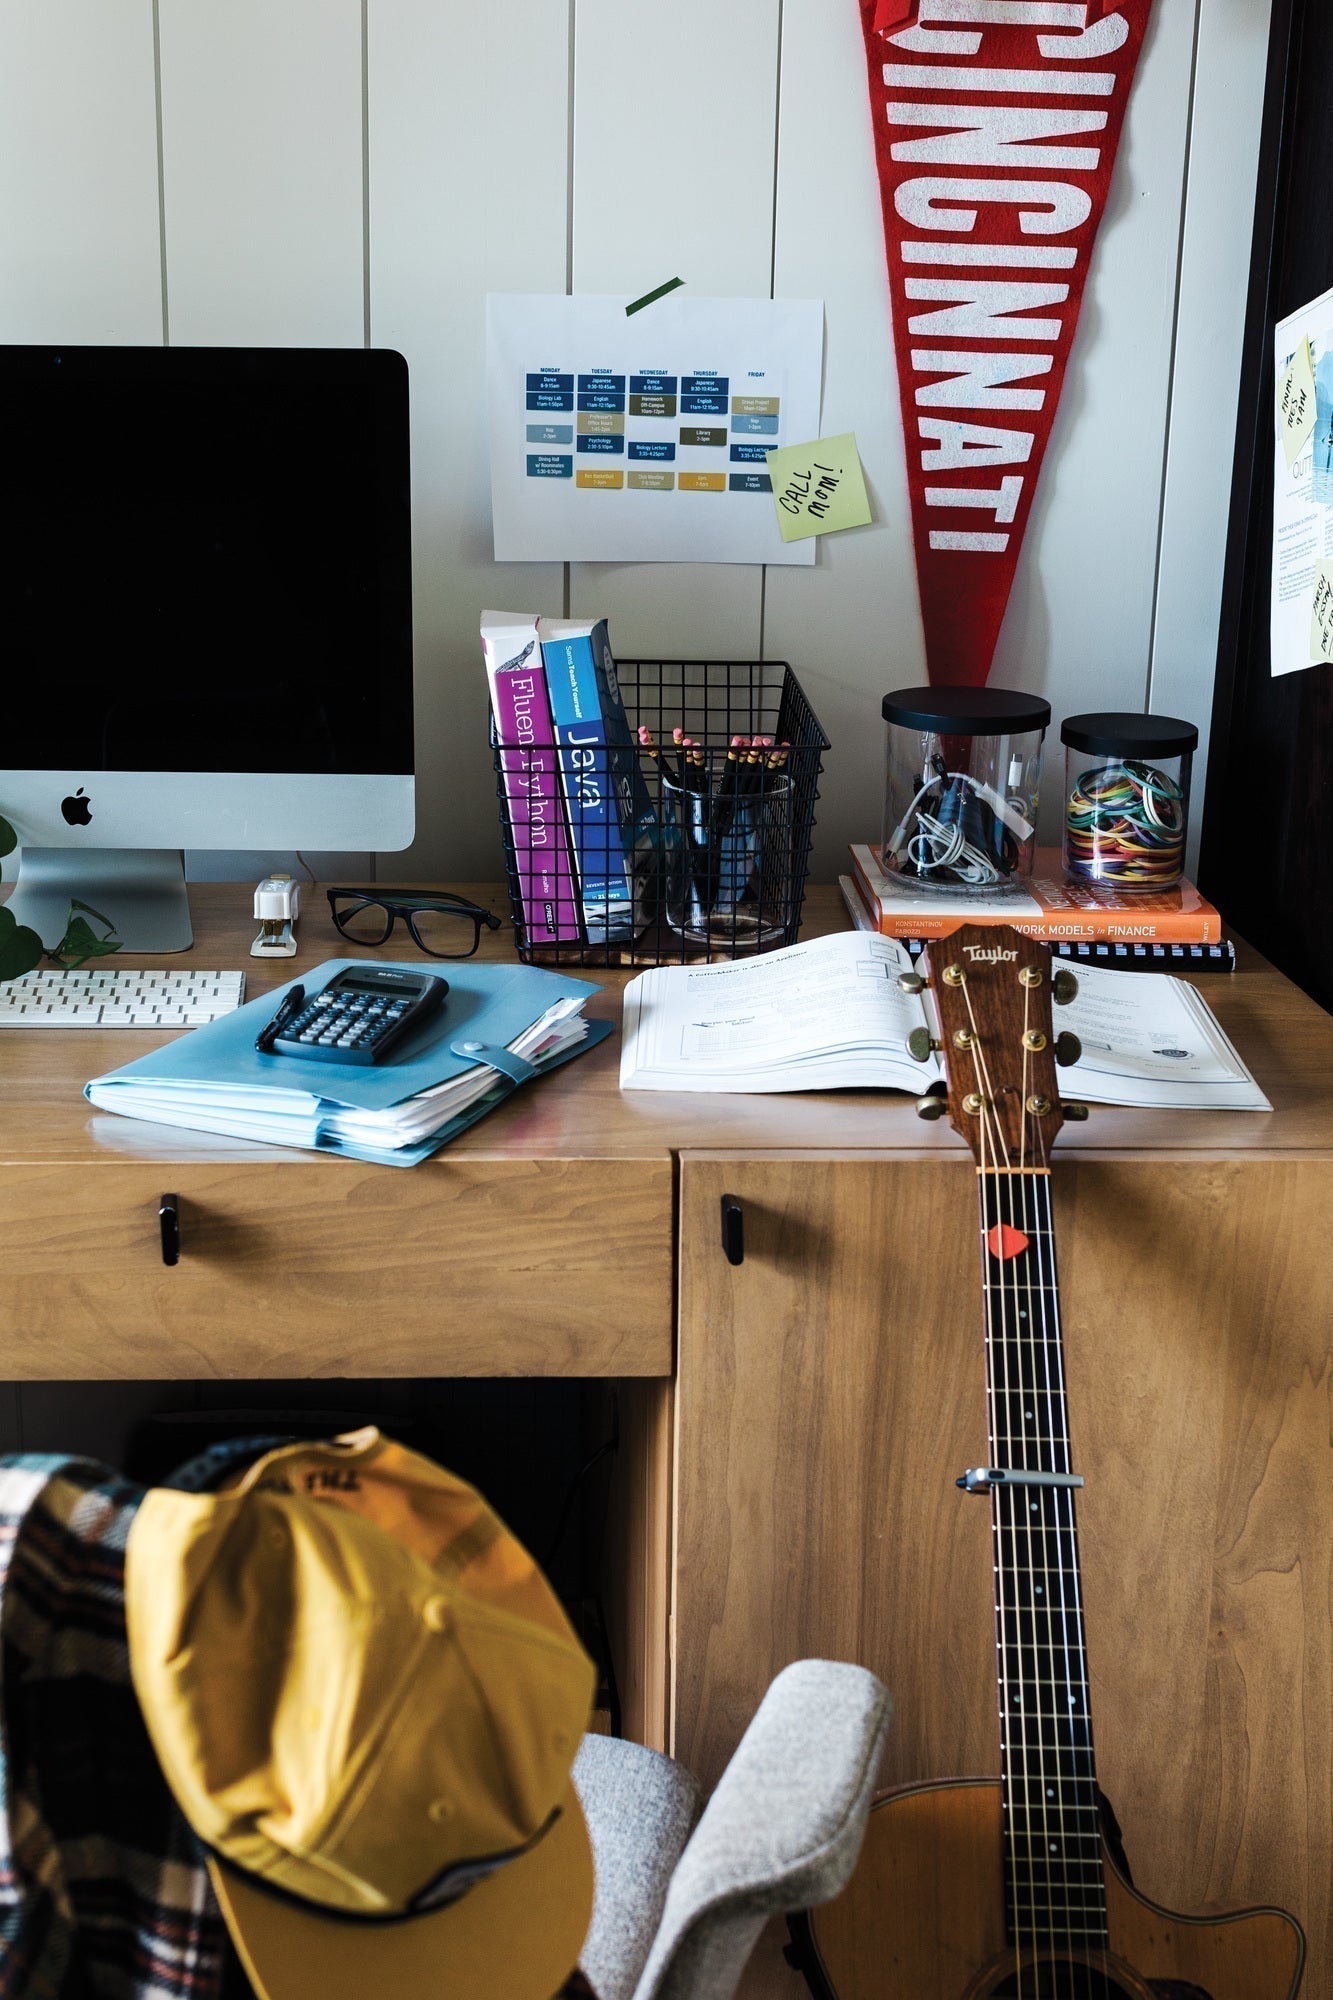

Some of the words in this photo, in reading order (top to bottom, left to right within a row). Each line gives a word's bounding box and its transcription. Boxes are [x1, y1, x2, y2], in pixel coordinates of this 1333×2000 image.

[880, 0, 1130, 553] CINCINNATI
[778, 470, 812, 514] CALL
[568, 731, 601, 809] Java
[1048, 924, 1094, 936] MODELS
[1096, 927, 1106, 935] in
[1108, 926, 1157, 937] FINANCE
[962, 944, 1018, 966] Taylor
